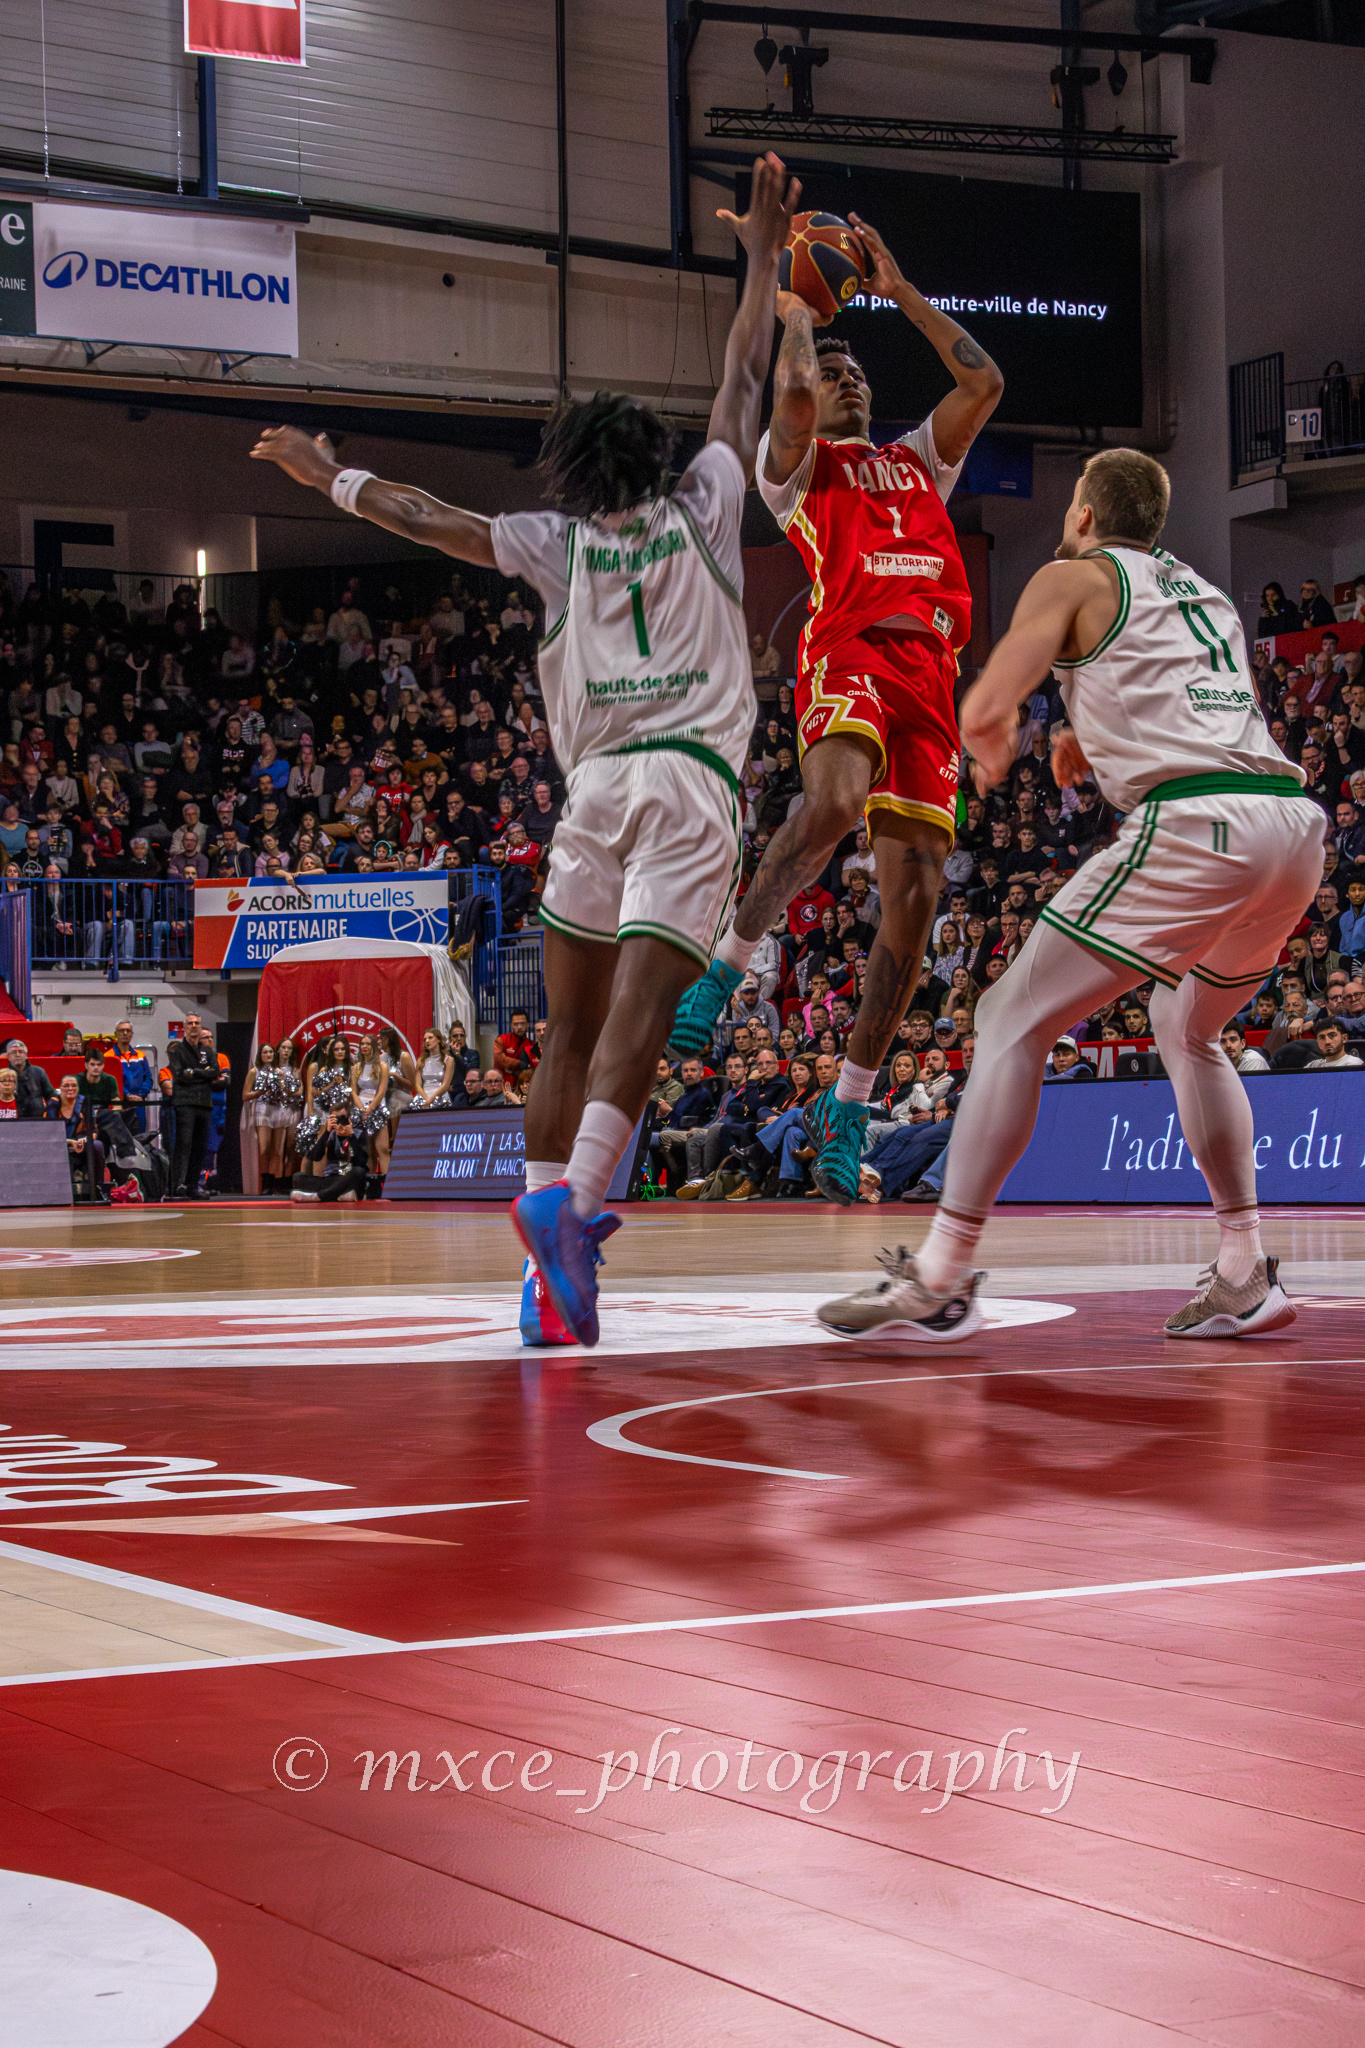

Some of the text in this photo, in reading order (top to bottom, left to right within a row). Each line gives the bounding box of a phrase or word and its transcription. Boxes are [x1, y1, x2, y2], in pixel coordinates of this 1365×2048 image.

[95, 258, 290, 304] DECATHLON
[1027, 298, 1048, 314] de
[1053, 301, 1107, 320] Nancy
[1301, 411, 1319, 438] 10
[887, 506, 906, 538] 1
[874, 554, 944, 572] BTP LORRAINE
[626, 582, 650, 657] 1
[1177, 600, 1239, 673] 11
[806, 711, 827, 733] NCY
[1211, 821, 1228, 854] 11
[248, 888, 414, 911] ACORIS mutuelles
[247, 918, 348, 940] PARTENAIRE
[246, 943, 279, 960] SLUC
[438, 1132, 486, 1153] MAISON
[499, 1132, 512, 1150] LA
[1288, 1107, 1343, 1169] du
[433, 1158, 526, 1178] BRAJOU NANCY
